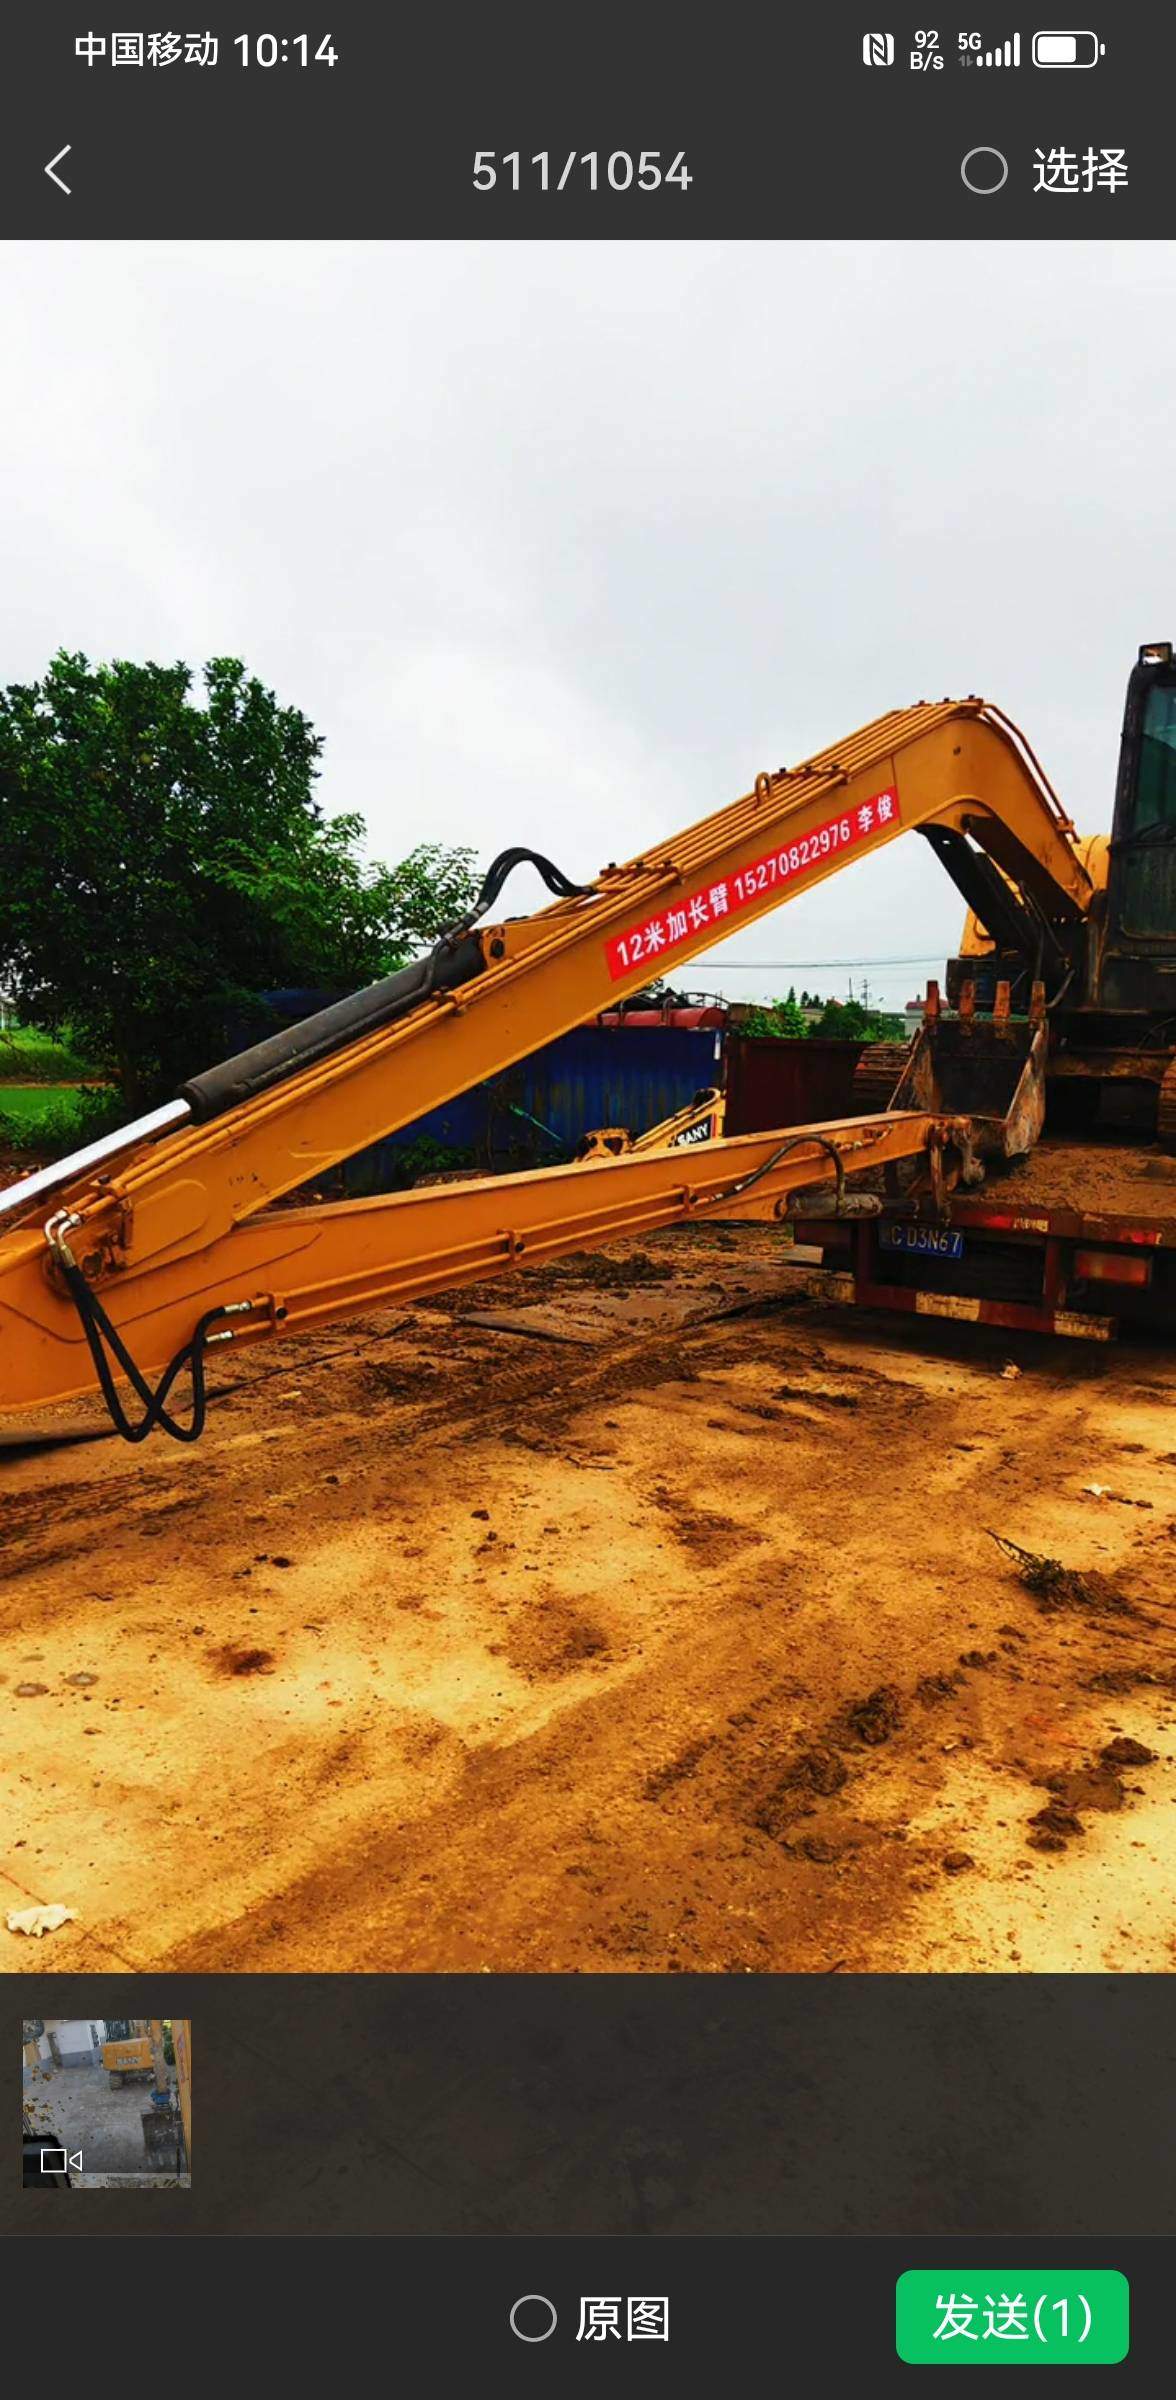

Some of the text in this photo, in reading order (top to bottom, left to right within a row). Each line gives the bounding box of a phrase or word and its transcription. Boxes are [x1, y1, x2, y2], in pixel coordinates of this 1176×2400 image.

[616, 883, 729, 966] 12米加长臂
[734, 819, 850, 900] 15270822976
[677, 1122, 708, 1145] SANY
